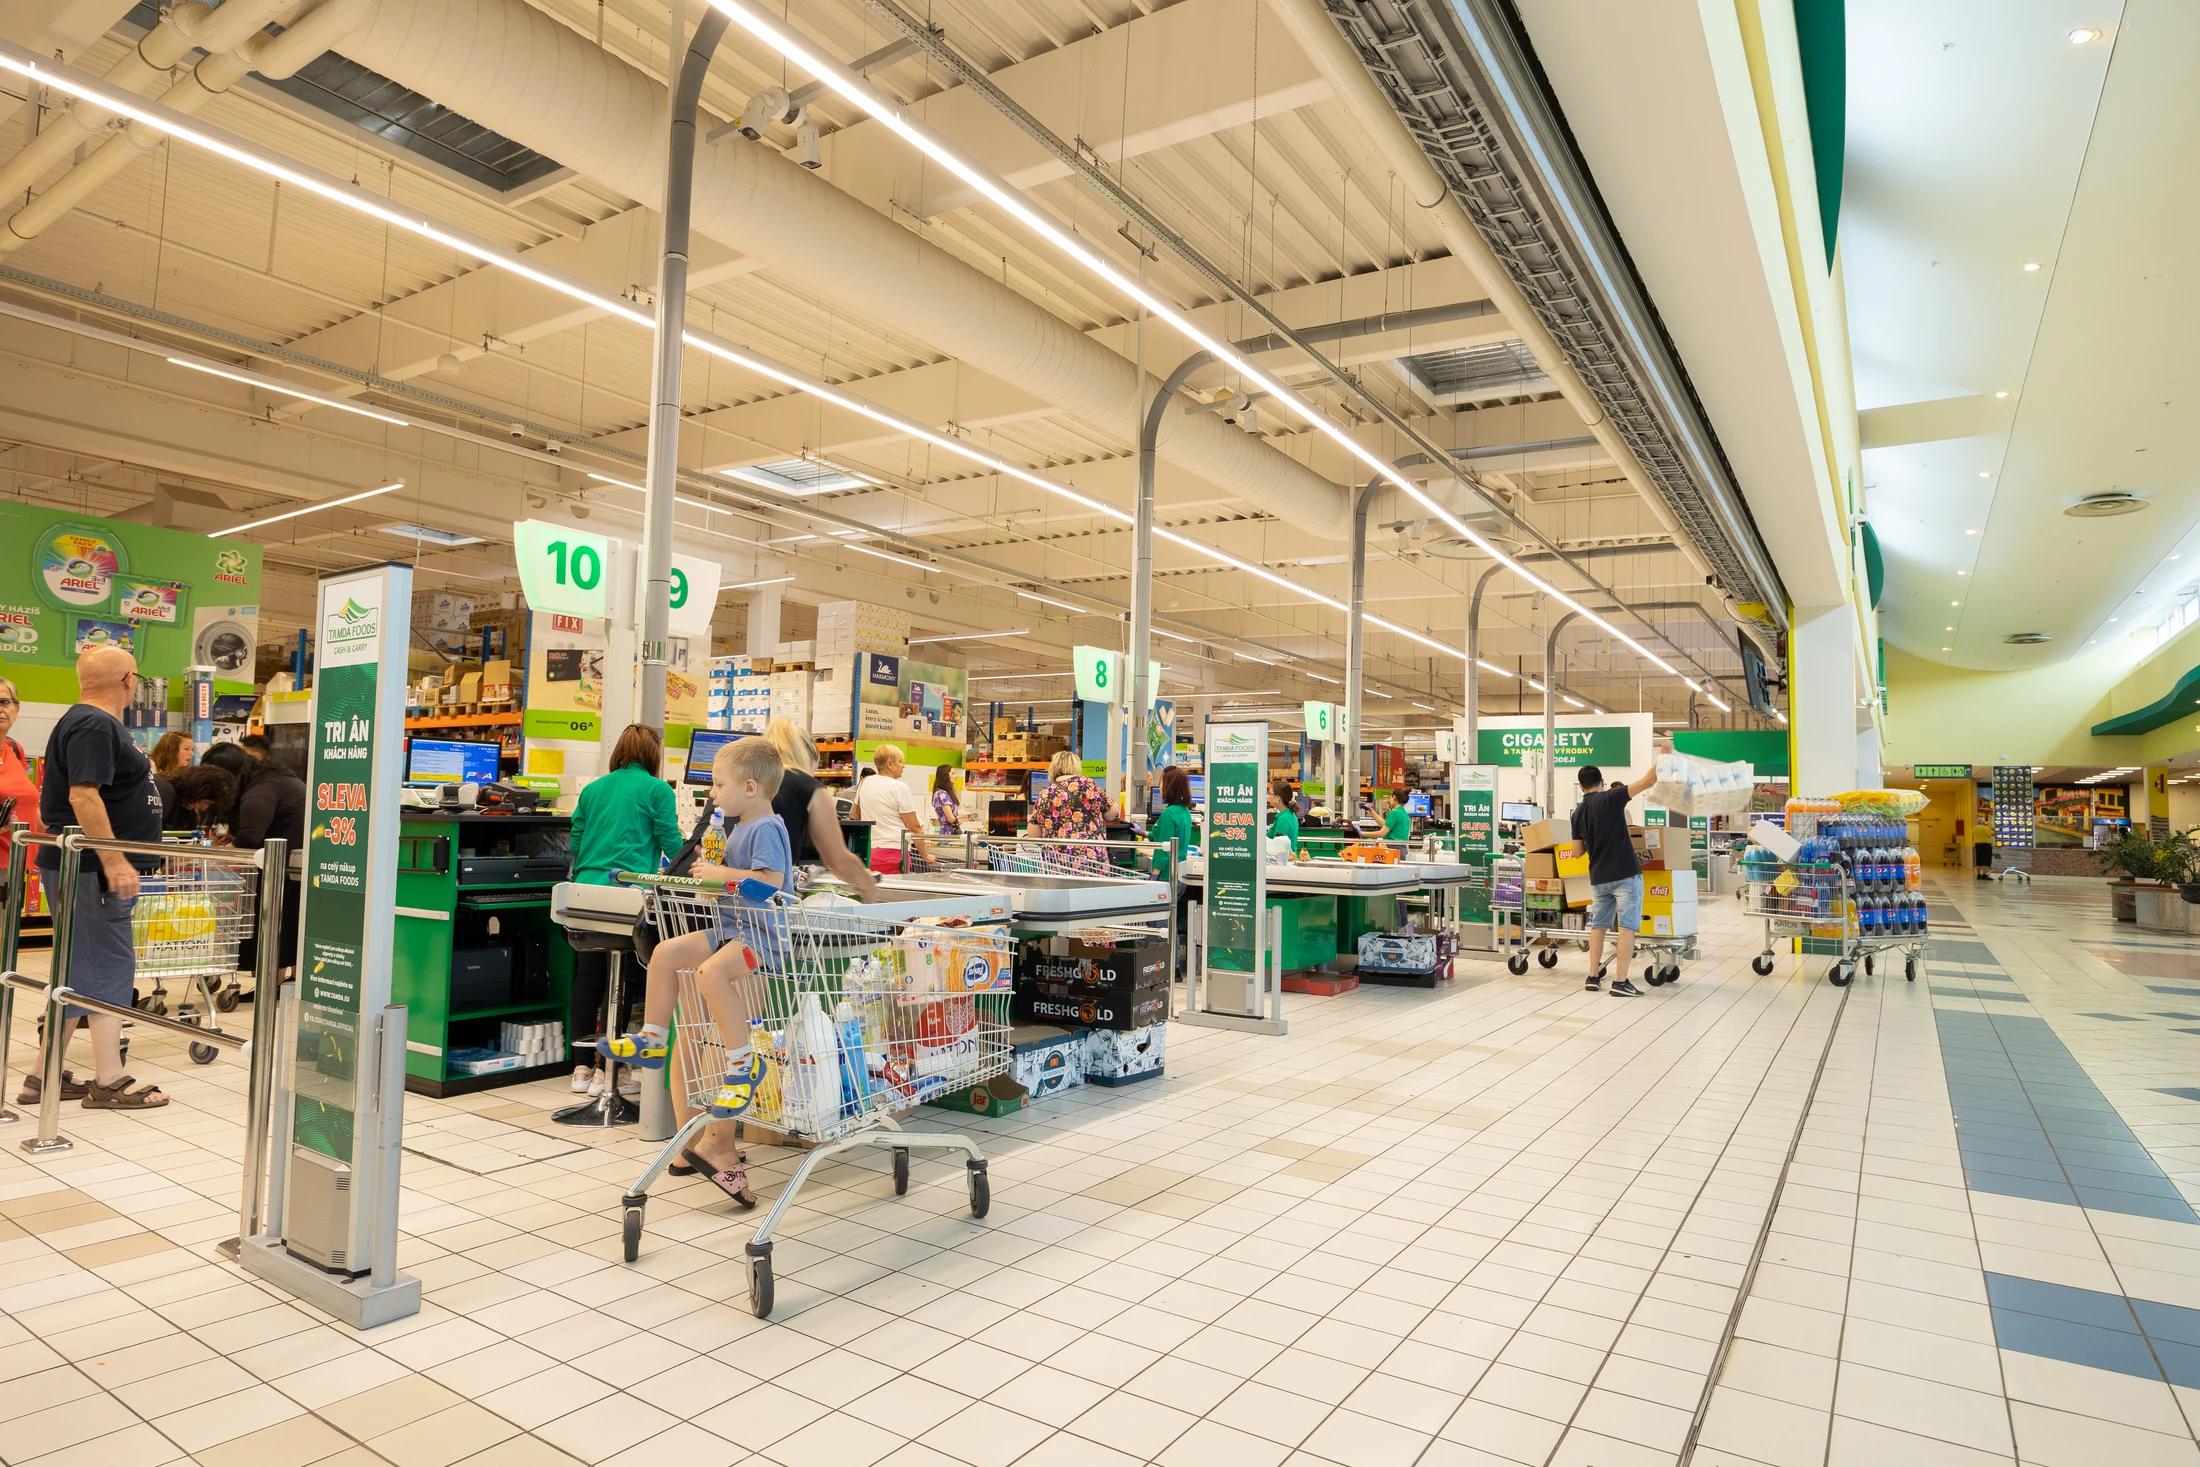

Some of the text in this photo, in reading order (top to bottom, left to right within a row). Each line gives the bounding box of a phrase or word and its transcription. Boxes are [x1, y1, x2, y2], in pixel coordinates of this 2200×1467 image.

[547, 541, 600, 590] 10
[60, 578, 100, 590] ARIEL
[213, 573, 247, 585] ARIEL
[669, 567, 688, 609] 9
[0, 611, 33, 627] RIEL
[130, 606, 166, 618] ARIEL
[555, 615, 578, 629] FIX
[329, 623, 376, 640] TAMDA FOODS
[334, 646, 347, 655] CASH
[352, 643, 367, 653] CARRY
[872, 673, 896, 681] HARMONY
[1095, 660, 1107, 688] 8
[1320, 710, 1327, 730] 6
[325, 714, 370, 743] TRI ÂN
[323, 744, 368, 760] KHÁCH HÀNG
[317, 782, 367, 811] SLEVA
[1216, 783, 1254, 796] TRI ÂN
[1464, 804, 1476, 812] TRI
[1213, 812, 1255, 825] SLEVA
[324, 816, 356, 846] -3%
[1221, 827, 1247, 840] -3%
[320, 861, 356, 875] na celý nákup
[320, 874, 359, 886] TAMDA FOODS
[1035, 962, 1117, 984] FRESHGOLD
[1033, 1001, 1114, 1023] FRESHGOLD
[973, 1093, 987, 1106] Jar
